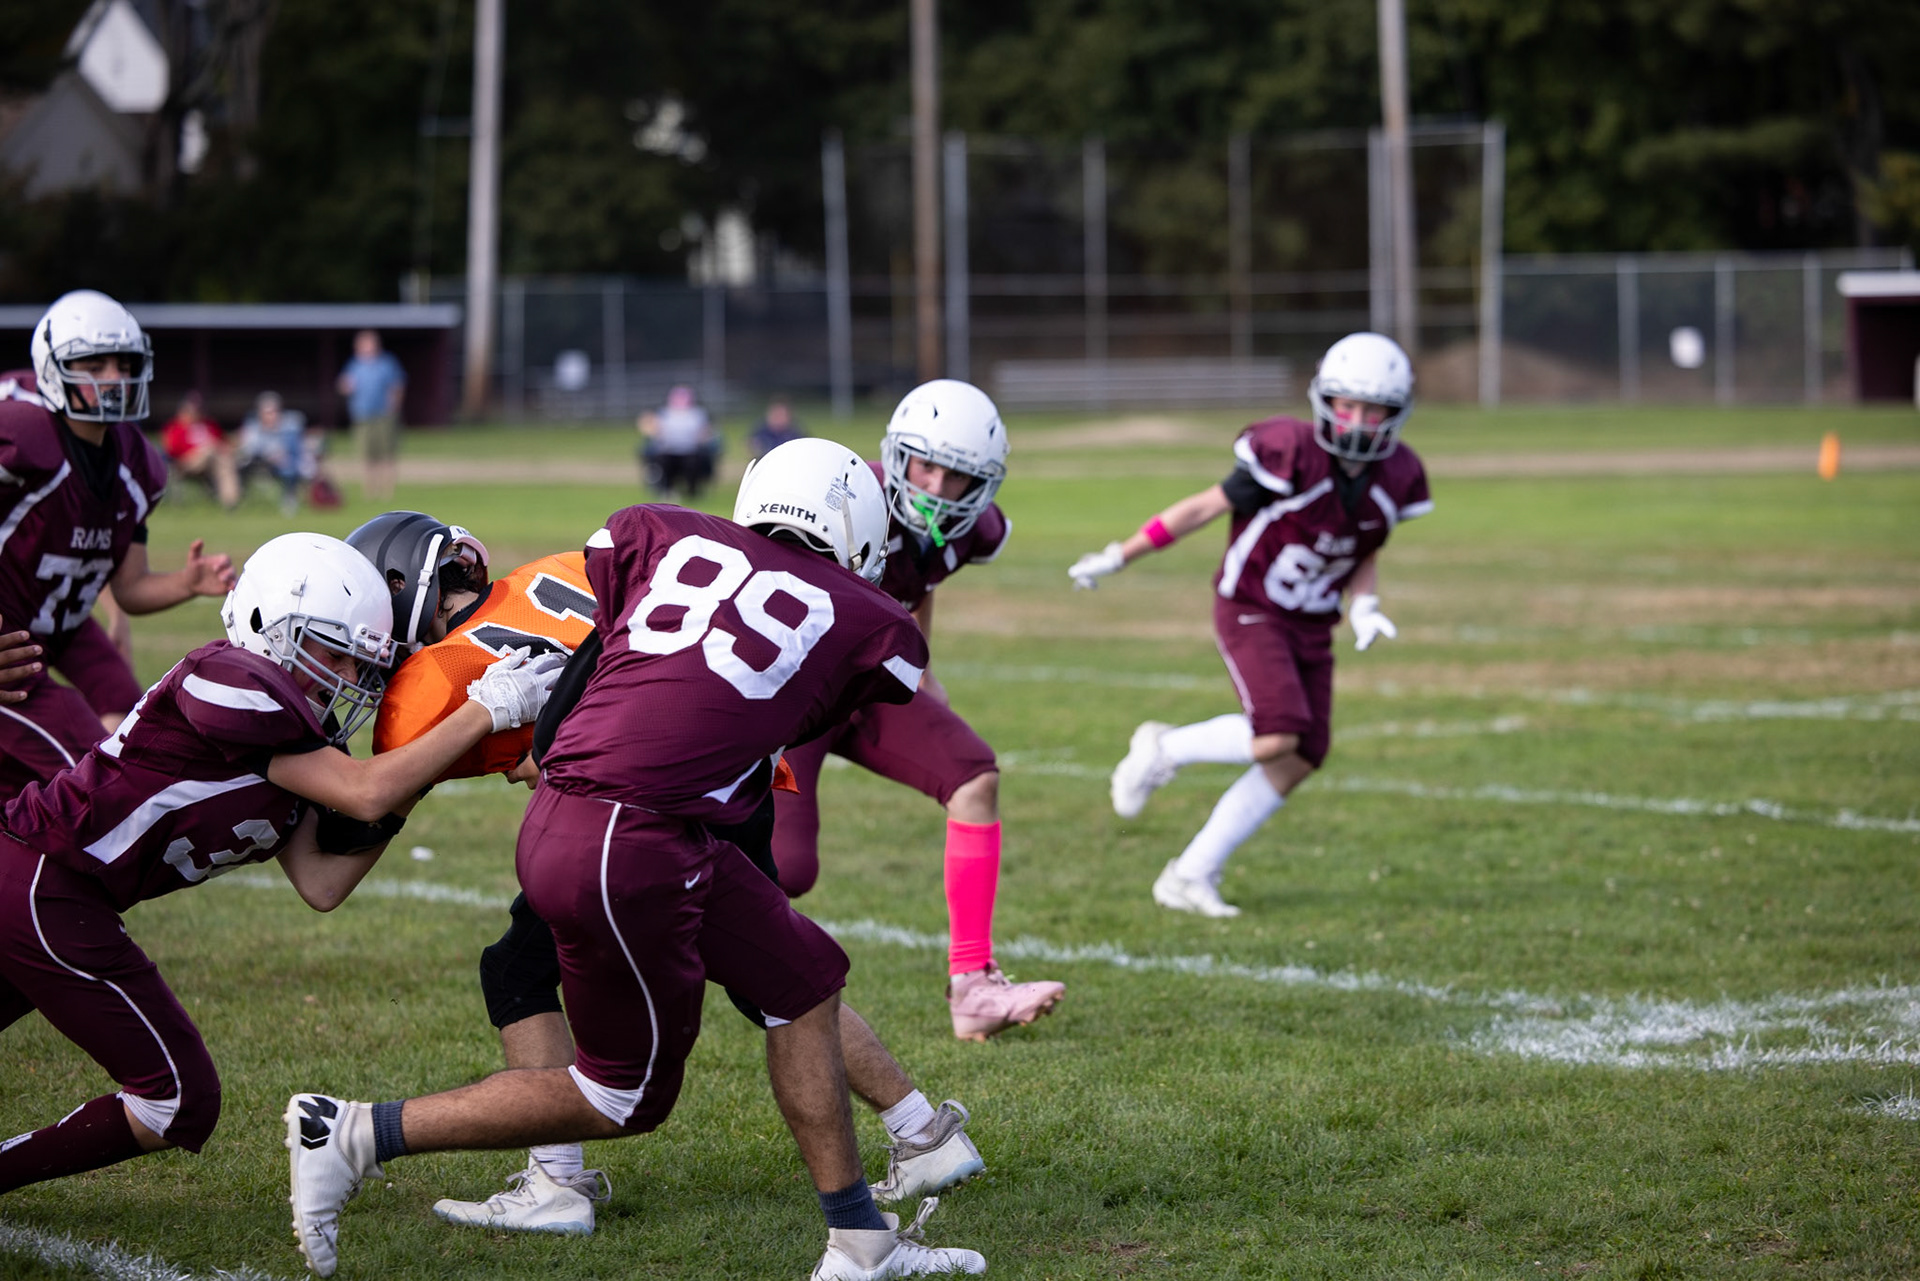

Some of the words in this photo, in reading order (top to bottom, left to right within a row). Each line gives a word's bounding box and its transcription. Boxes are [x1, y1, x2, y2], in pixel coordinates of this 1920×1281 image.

[758, 503, 817, 523] XENITH
[30, 553, 114, 634] 73
[627, 535, 835, 699] 89
[163, 819, 280, 882] 3
